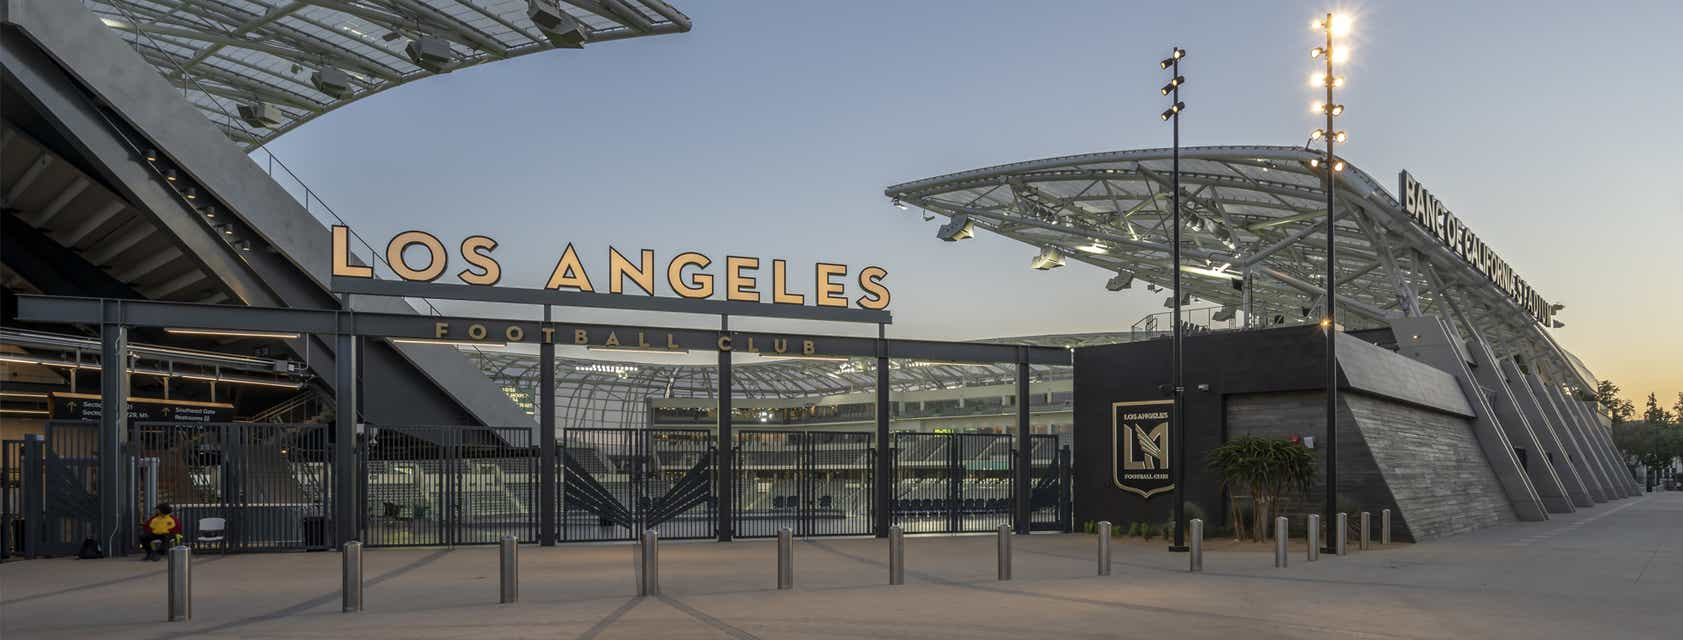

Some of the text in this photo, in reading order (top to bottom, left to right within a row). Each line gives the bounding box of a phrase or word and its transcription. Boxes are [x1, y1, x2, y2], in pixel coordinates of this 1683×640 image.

[1401, 171, 1445, 241] BANC
[1446, 210, 1464, 255] OF
[1464, 226, 1517, 299] CALIFORNIA
[332, 225, 891, 310] LOS ANGELES
[435, 322, 815, 354] FOOTBALL CLUB
[1138, 412, 1169, 420] ANGELES
